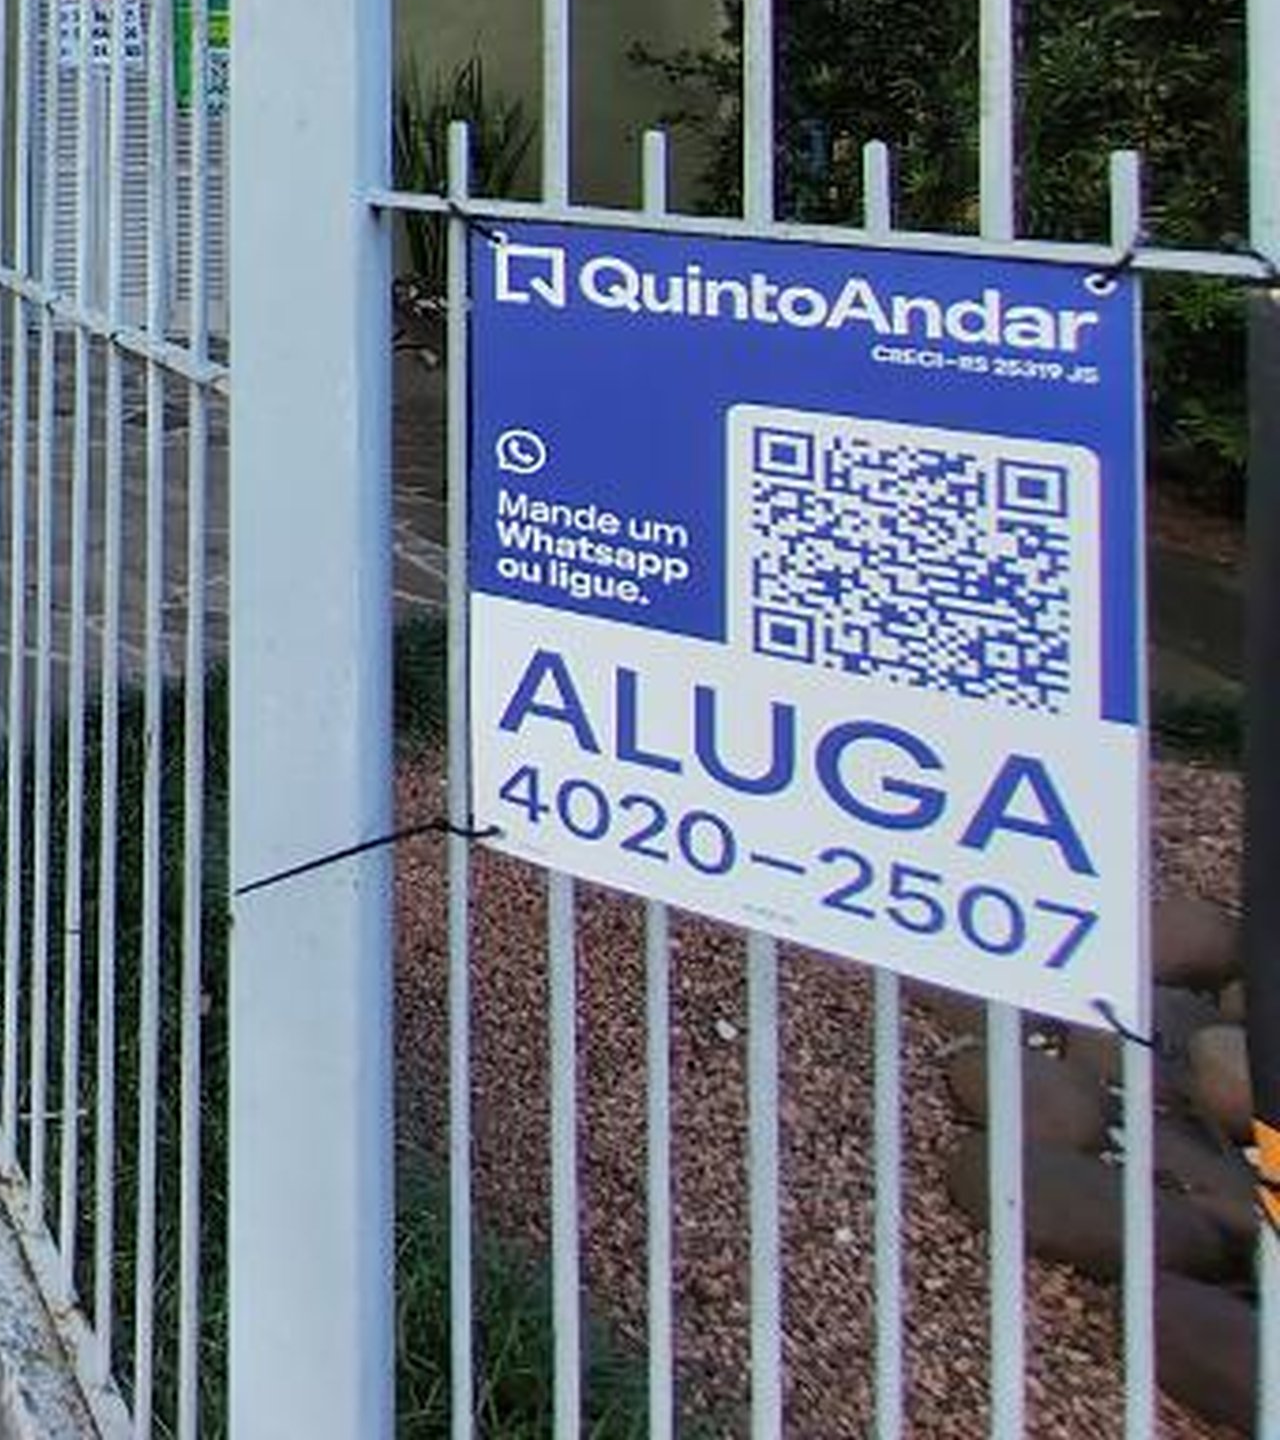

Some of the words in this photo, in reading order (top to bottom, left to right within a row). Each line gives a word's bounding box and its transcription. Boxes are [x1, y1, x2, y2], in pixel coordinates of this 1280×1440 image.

[578, 256, 1100, 351] QuintoAndar
[496, 518, 690, 584] Whatsapp
[497, 489, 621, 535] Mande
[628, 517, 689, 548] um
[496, 557, 541, 583] ou
[548, 558, 651, 606] ligue.
[498, 649, 1100, 878] ALUGA
[498, 765, 1099, 971] 4020-2507
